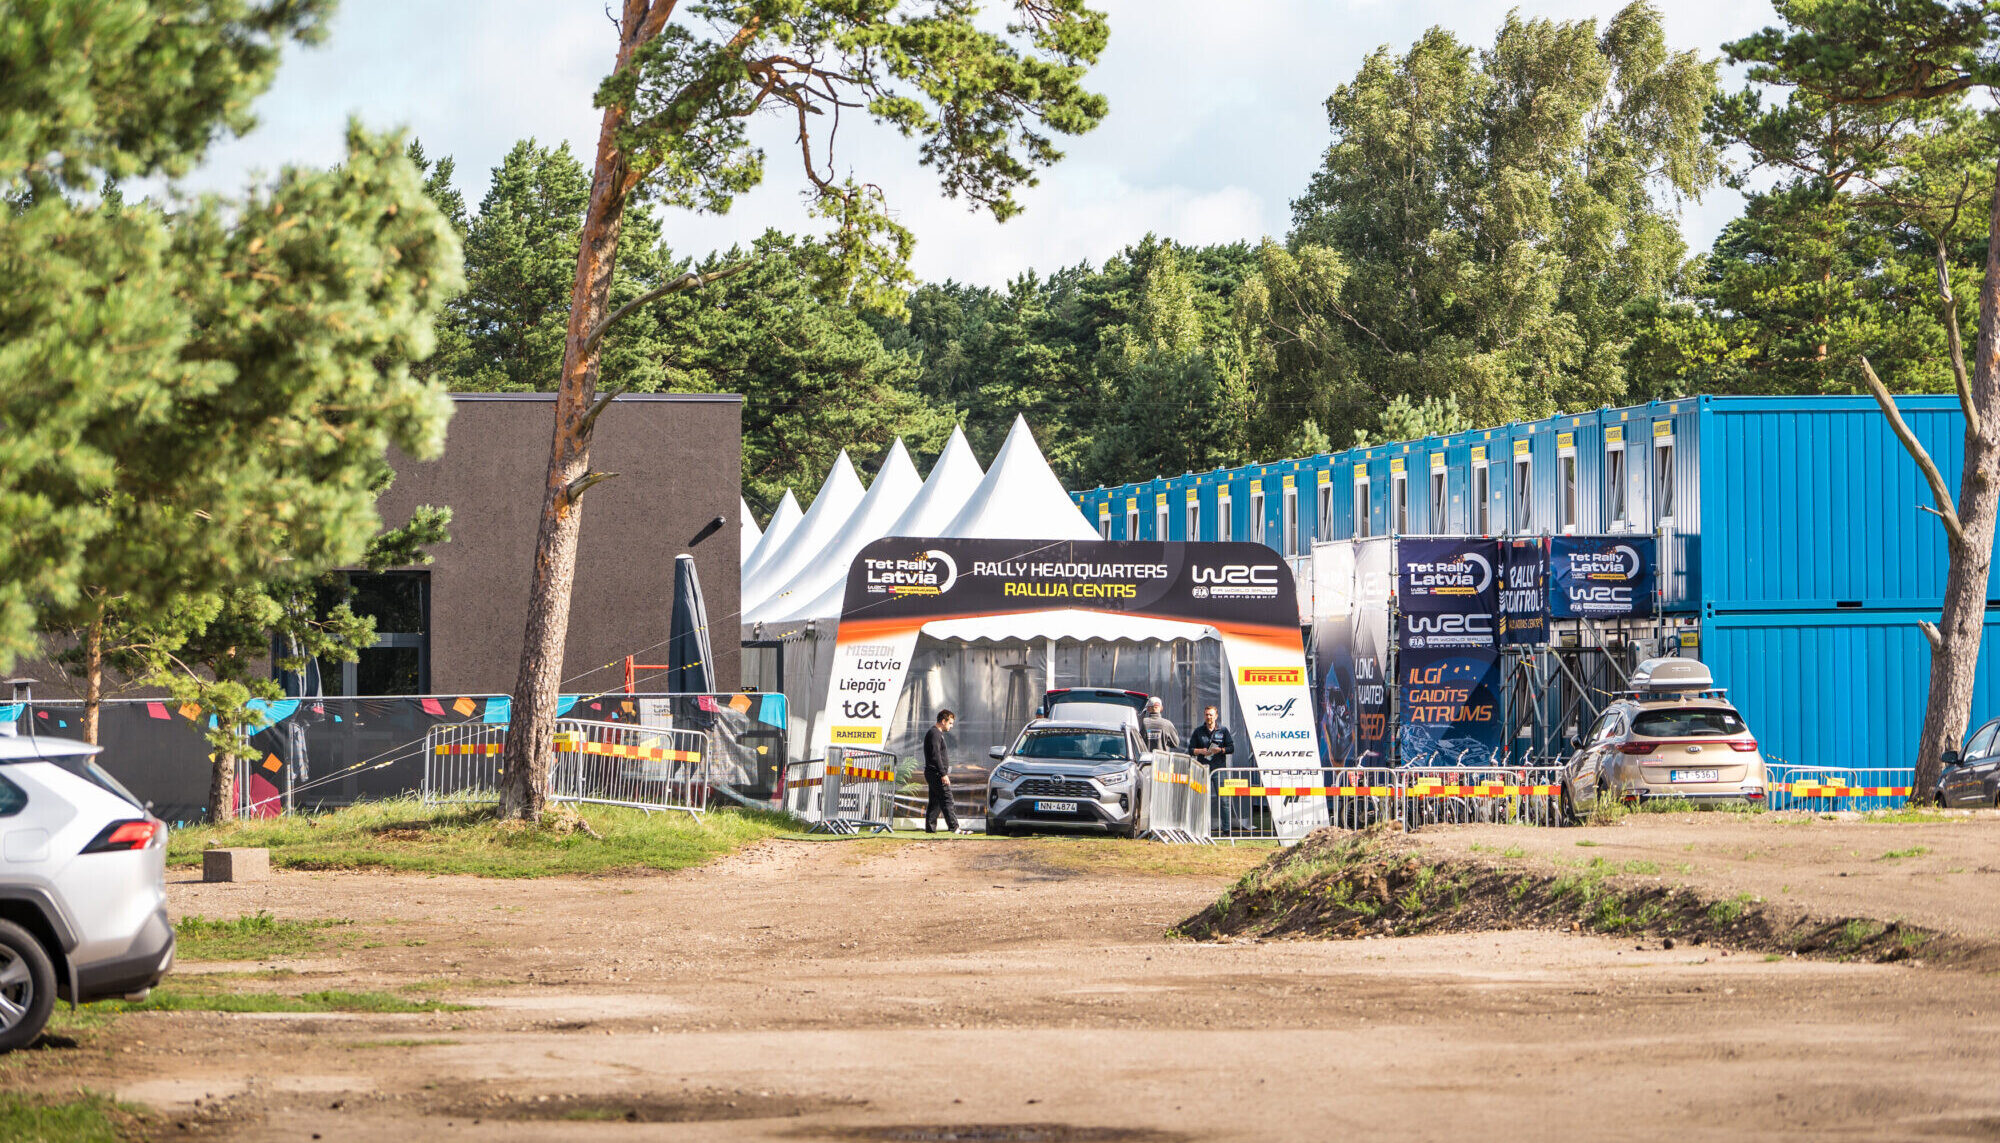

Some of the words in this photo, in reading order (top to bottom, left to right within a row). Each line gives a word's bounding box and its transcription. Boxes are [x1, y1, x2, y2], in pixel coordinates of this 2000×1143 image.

[865, 559, 894, 570] Tet
[897, 559, 937, 572] Rally
[1568, 553, 1588, 562] Tet
[1592, 553, 1623, 563] Rally
[973, 561, 1027, 576] RALLY
[1031, 562, 1168, 580] HEADQUARTERS
[1192, 564, 1278, 584] WRC
[1407, 562, 1434, 573] Tet
[1436, 562, 1474, 574] Rally
[1571, 562, 1624, 572] Latvia
[867, 570, 937, 584] Latvia
[1410, 573, 1474, 586] Latvia
[1509, 564, 1536, 588] RALLY
[1004, 582, 1069, 597] RALLIJA
[1073, 583, 1136, 598] CENTRS
[1193, 586, 1209, 597] FIA
[1569, 586, 1632, 601] WRC
[1505, 589, 1540, 613] CONTROL
[1408, 613, 1493, 633] WRC
[1409, 638, 1424, 646] FIA
[846, 645, 895, 657] MISSION
[857, 658, 901, 670] Latvia
[1355, 658, 1374, 679] LONG
[1244, 669, 1298, 682] PIRELLI
[1409, 667, 1442, 684] ILGI
[839, 678, 886, 693] Liepāja
[1409, 686, 1469, 702] GAIDĪTS
[842, 700, 881, 719] tet
[1408, 705, 1493, 722] ĀTRUMS
[1360, 713, 1385, 740] SPEED
[836, 730, 877, 739] RAMIRENT
[1040, 802, 1076, 811] NN-4874
